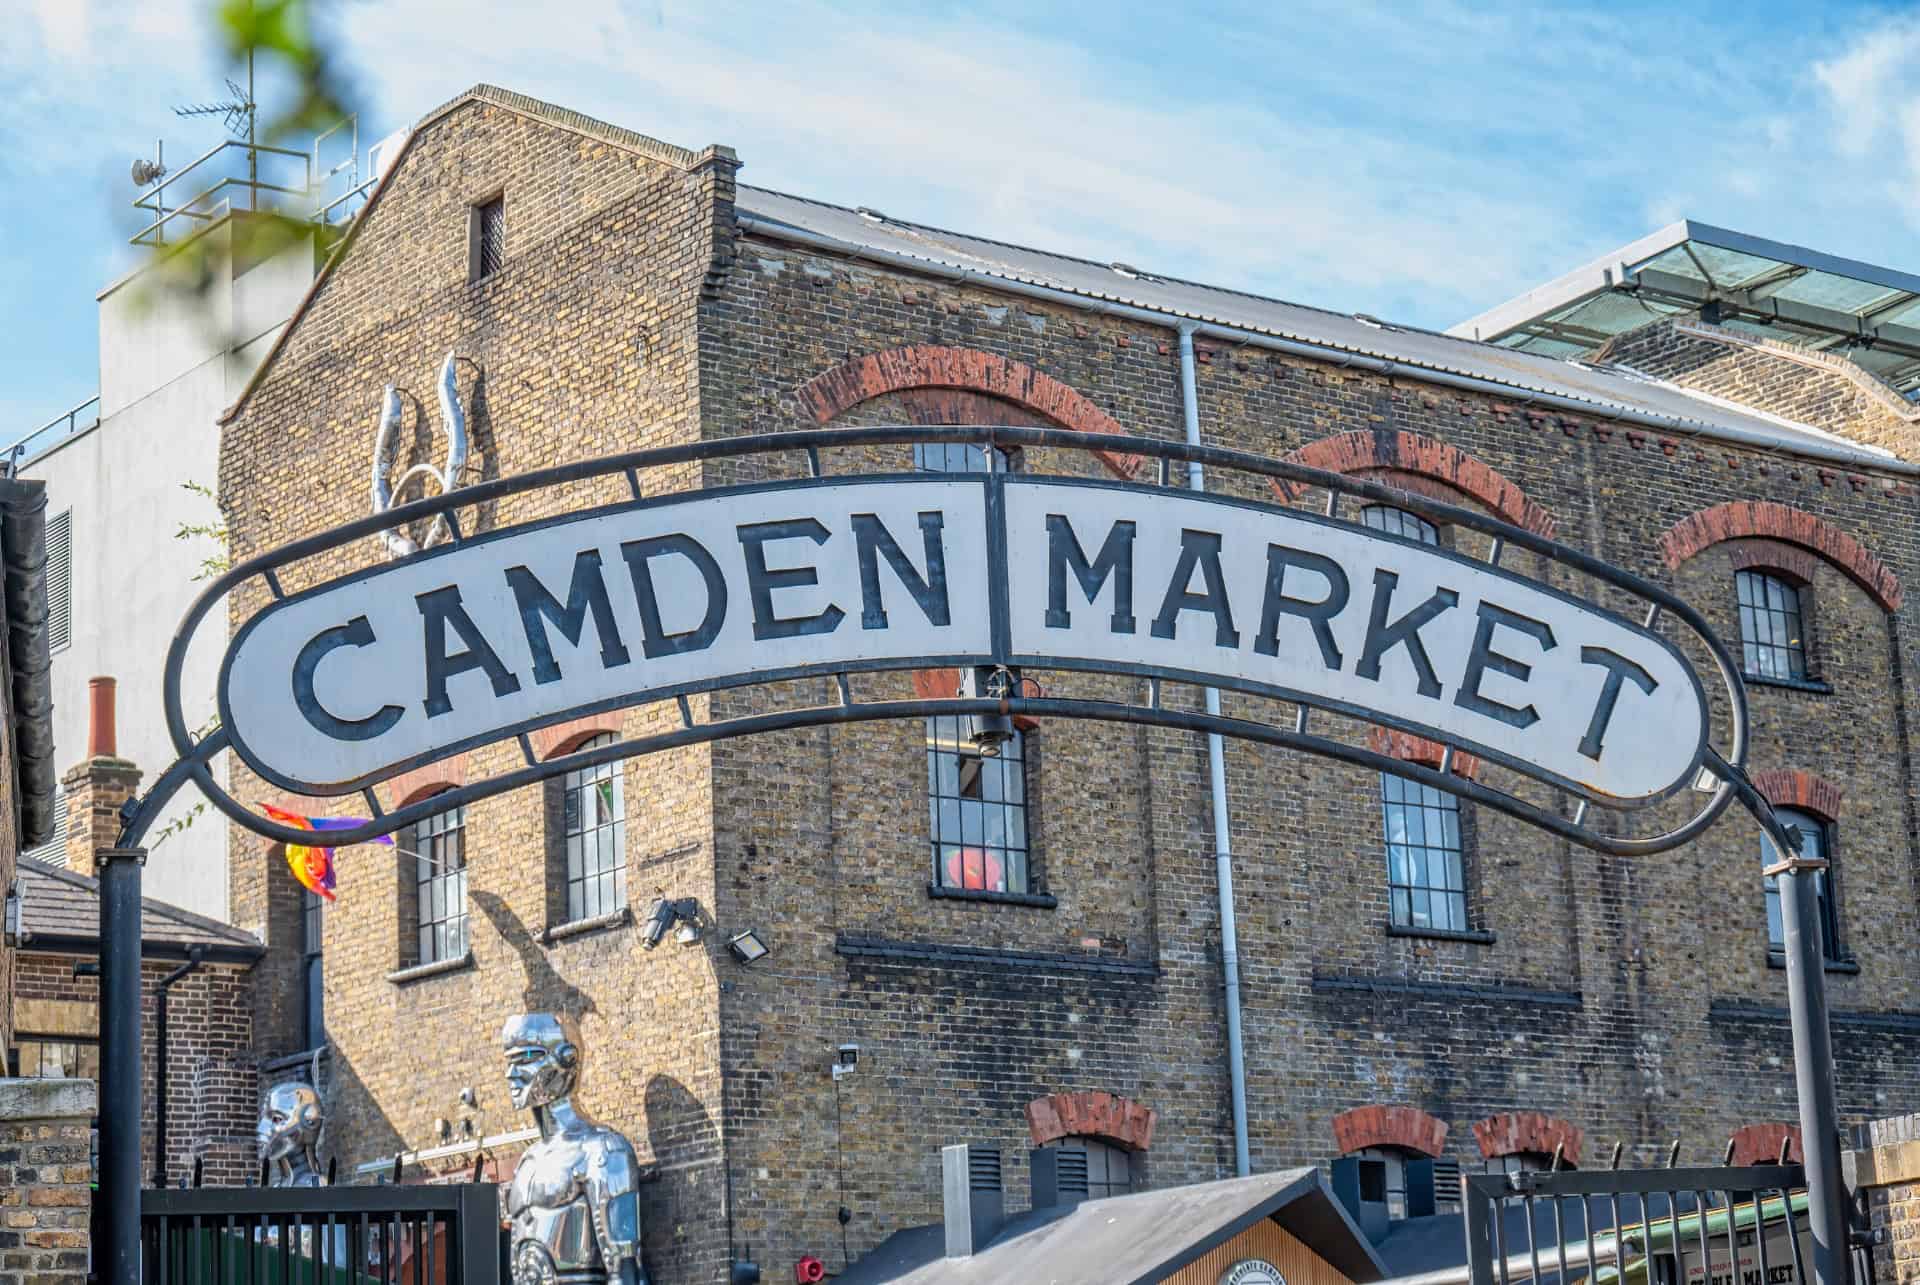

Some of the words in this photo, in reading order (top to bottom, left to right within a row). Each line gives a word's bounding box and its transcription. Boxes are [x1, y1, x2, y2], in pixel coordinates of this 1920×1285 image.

[293, 510, 952, 742] CAMDEN
[1045, 513, 1659, 762] MARKET
[1743, 1264, 1794, 1285] MAKET
